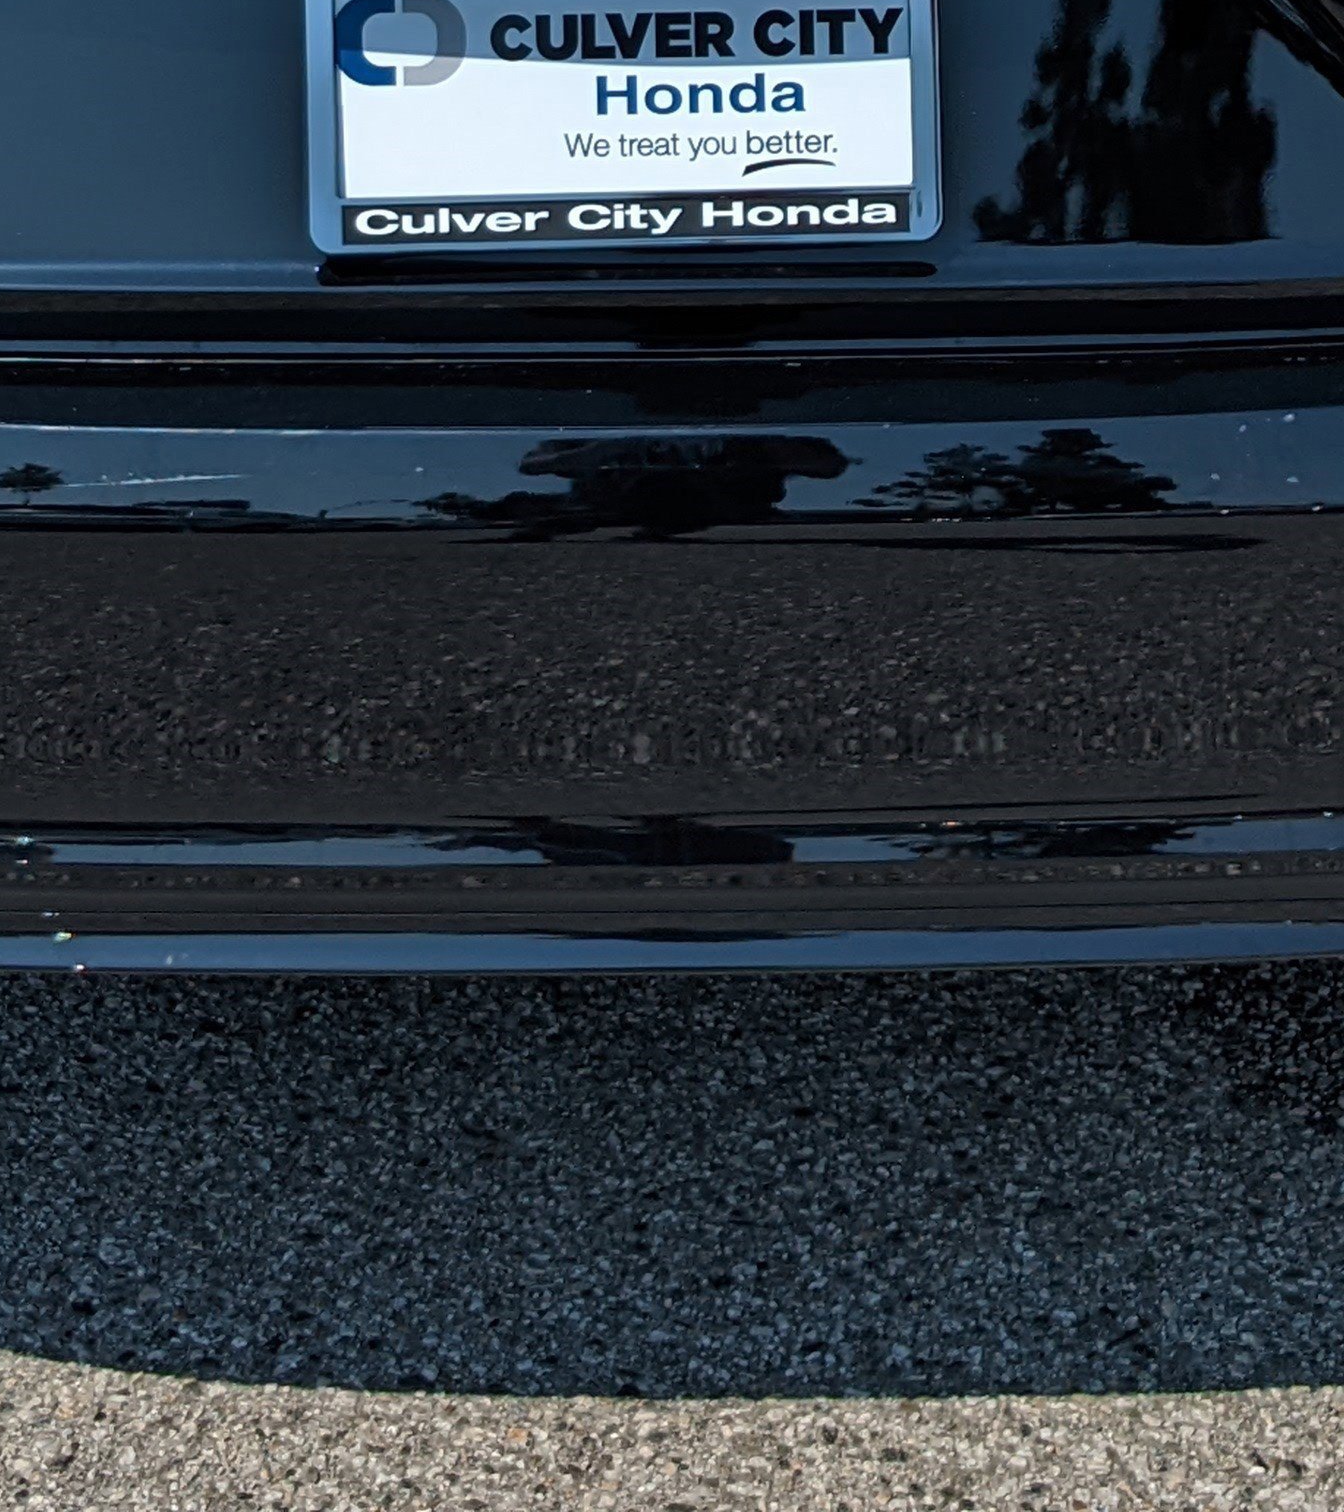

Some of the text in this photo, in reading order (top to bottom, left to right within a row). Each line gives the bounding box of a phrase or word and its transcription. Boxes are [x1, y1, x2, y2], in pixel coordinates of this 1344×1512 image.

[490, 7, 904, 62] CULVER CITY
[596, 74, 806, 116] Honda
[565, 130, 839, 162] We treat you better.
[355, 198, 897, 236] Culver City Honda
